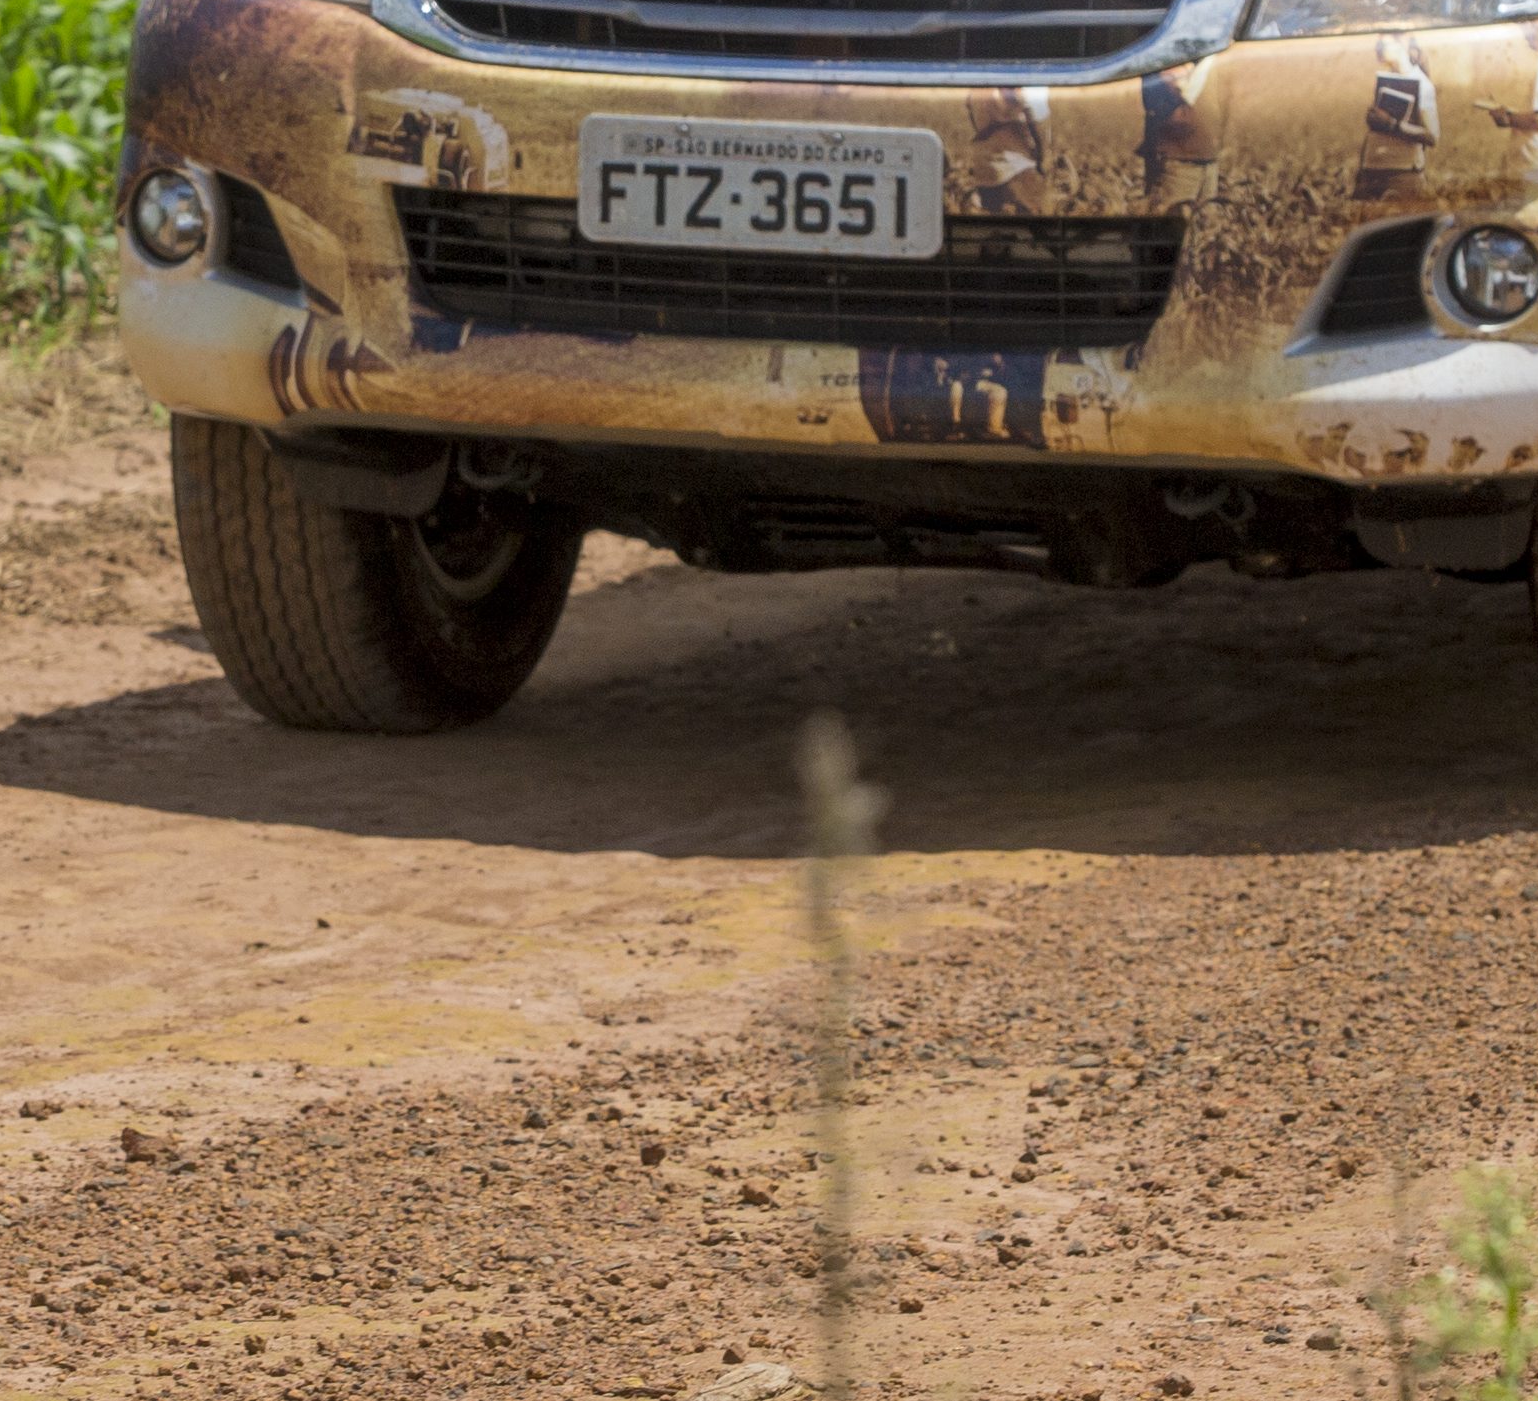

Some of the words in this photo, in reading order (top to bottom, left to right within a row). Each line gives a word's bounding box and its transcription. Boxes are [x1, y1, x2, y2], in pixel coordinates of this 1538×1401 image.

[711, 138, 798, 160] BERNARDO
[802, 143, 826, 161] DO
[828, 145, 886, 164] CAMPO
